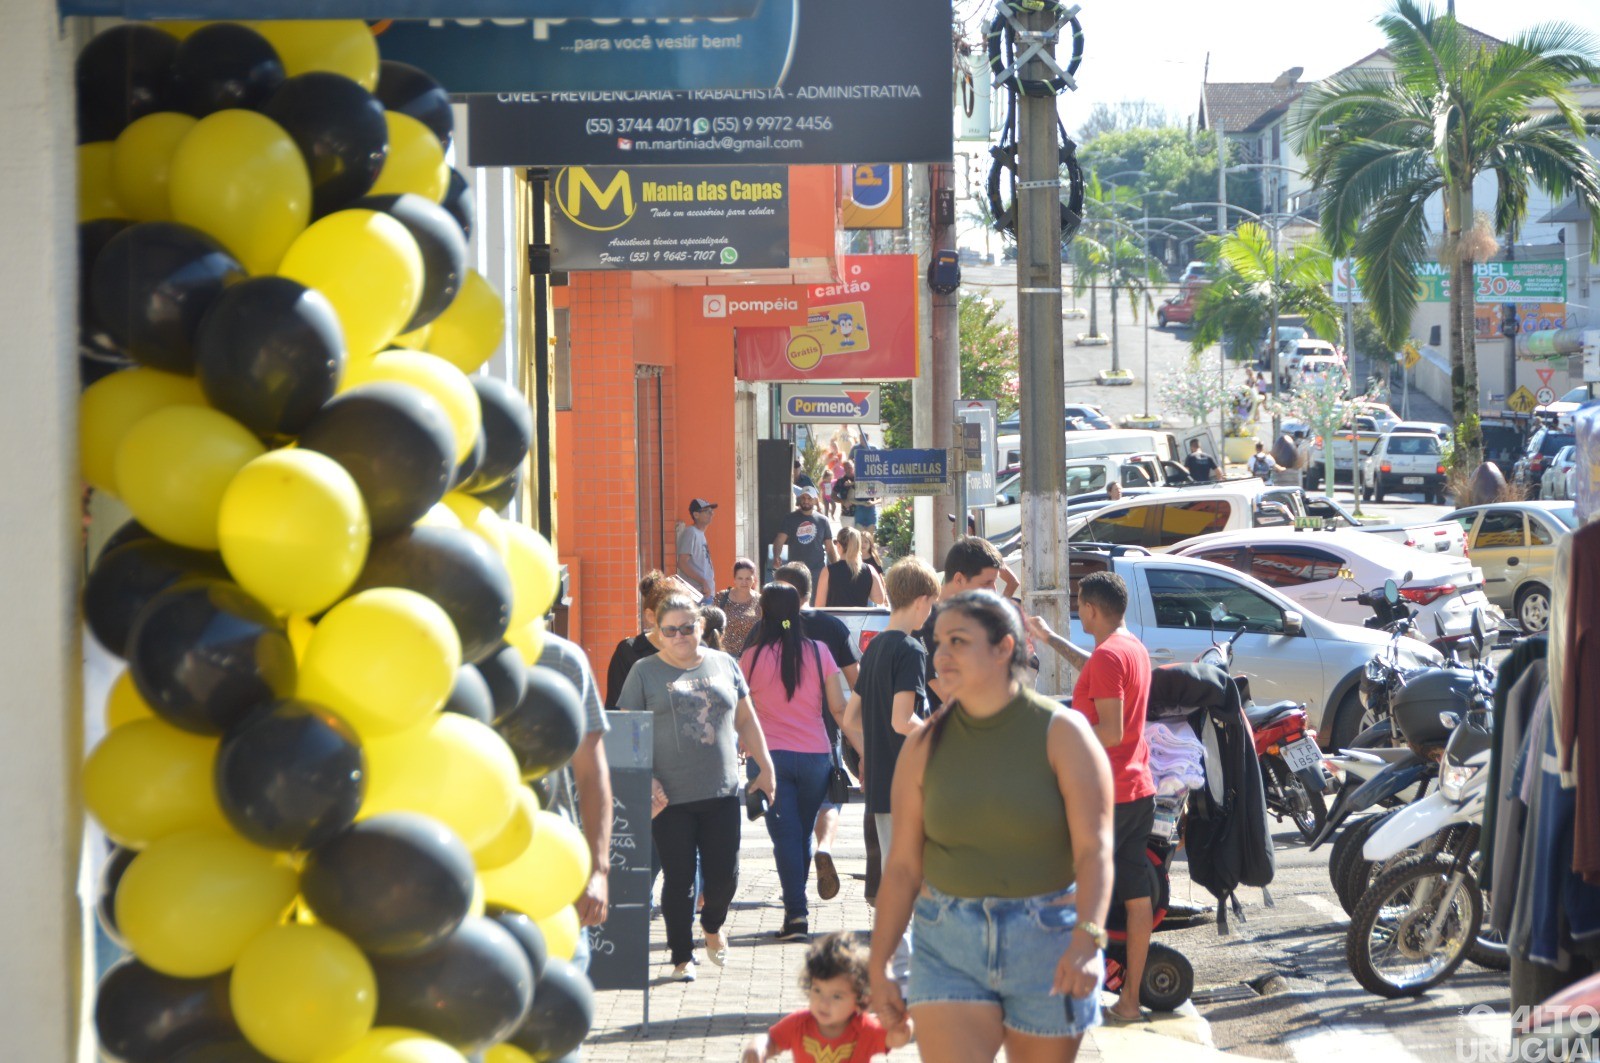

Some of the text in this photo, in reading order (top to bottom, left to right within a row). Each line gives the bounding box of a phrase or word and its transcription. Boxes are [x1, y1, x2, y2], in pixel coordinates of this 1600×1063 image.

[614, 35, 651, 49] você
[655, 35, 699, 49] vestir
[702, 33, 743, 48] bem!
[796, 85, 922, 99] ADMINISTRATIVA
[586, 117, 691, 135] (55) 3744 4071
[712, 116, 833, 133] (55) 9 9972 4456
[635, 136, 803, 152] m.martiniadv@gmail.com
[642, 180, 782, 202] Mania das Capas
[650, 208, 671, 218] Tudo
[687, 207, 725, 217] acessórios
[726, 209, 746, 218] para
[748, 206, 775, 216] celular
[608, 236, 729, 248] Assistência técnica especializada
[599, 250, 716, 265] Fone: (55) 9 9645-7107
[814, 279, 871, 298] cartão
[1476, 275, 1522, 296] 30%
[728, 297, 798, 315] pompéia
[794, 399, 862, 418] Pormenos
[864, 454, 880, 463] RUA
[864, 461, 942, 476] JOSÉ CANELLAS
[1296, 518, 1320, 528] TAXI
[1293, 752, 1320, 768] 1853
